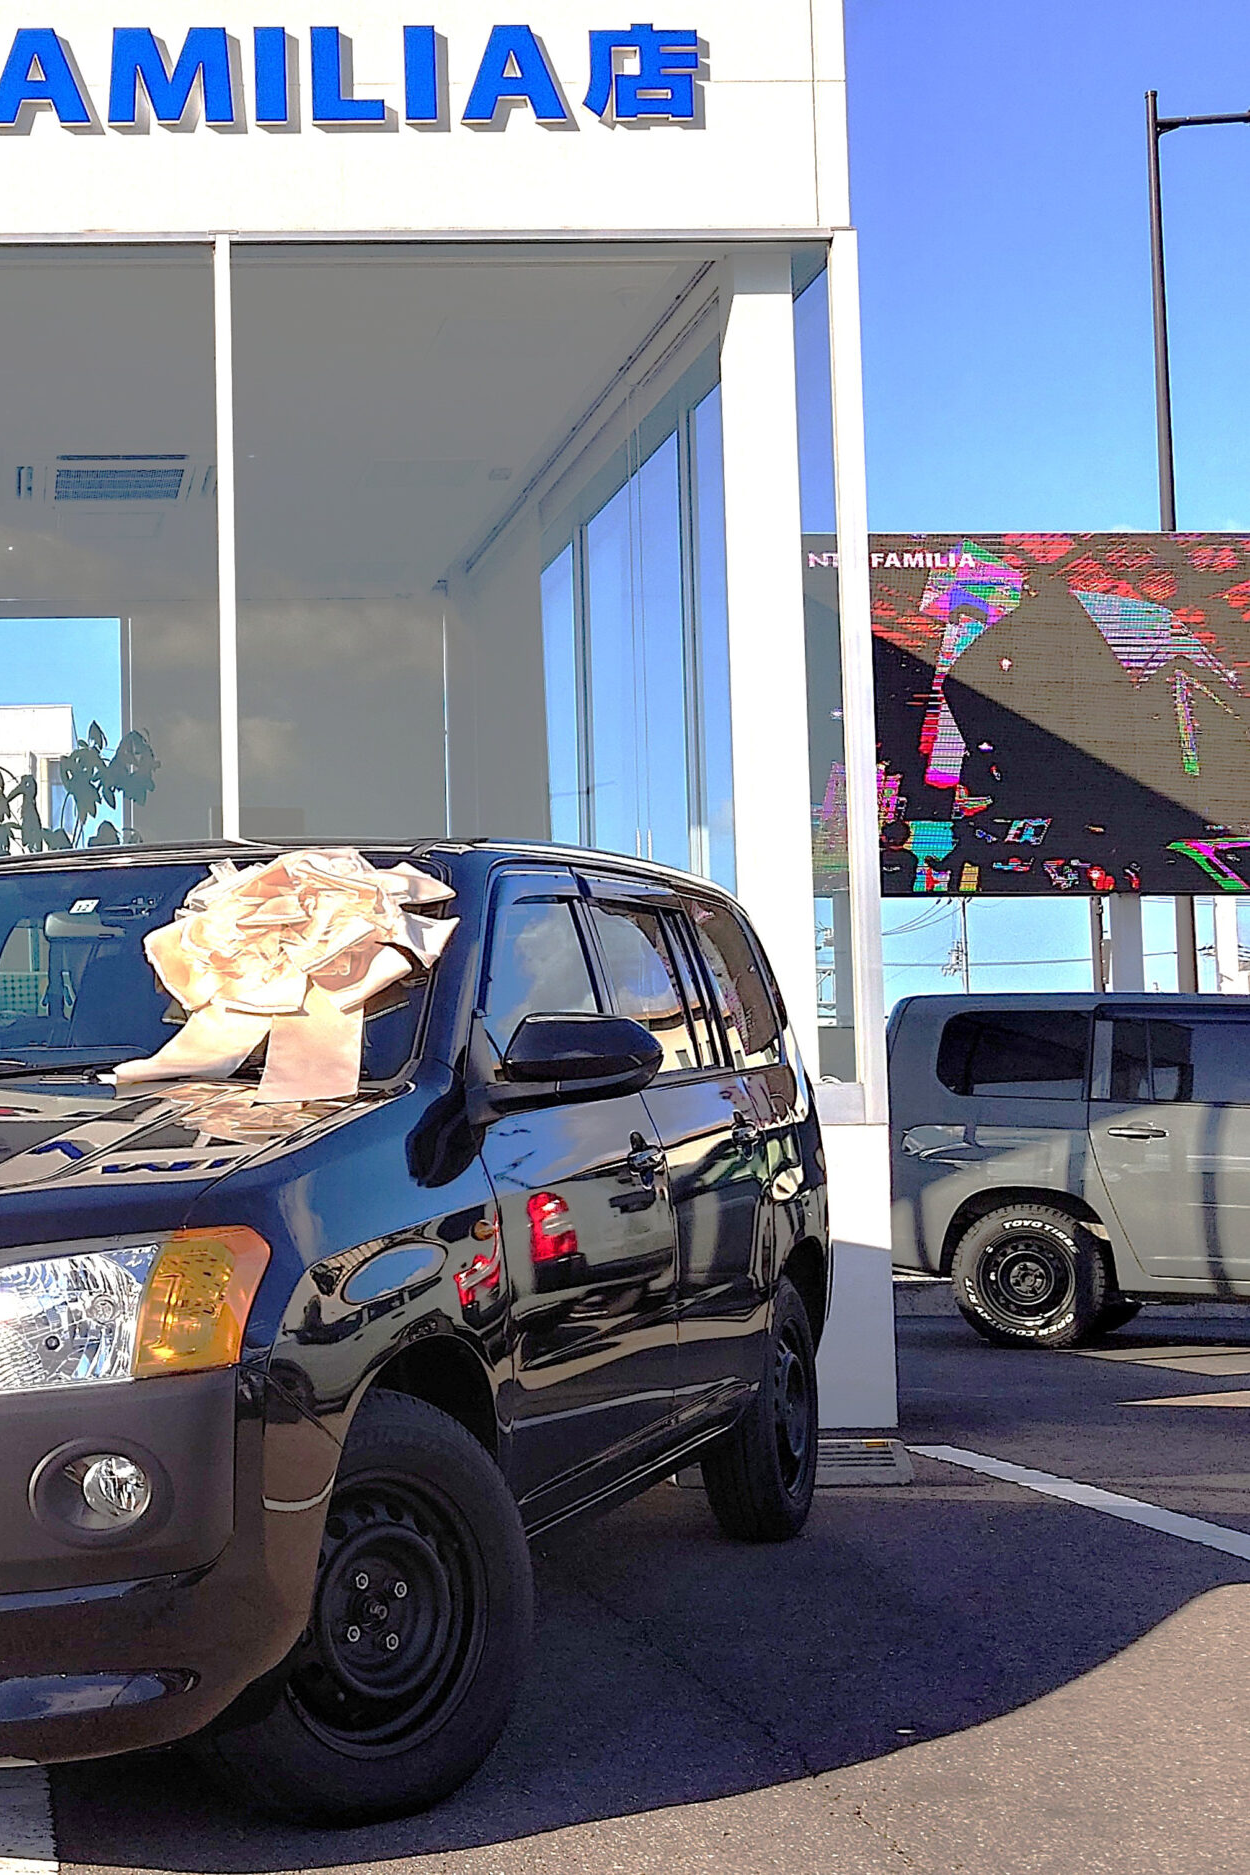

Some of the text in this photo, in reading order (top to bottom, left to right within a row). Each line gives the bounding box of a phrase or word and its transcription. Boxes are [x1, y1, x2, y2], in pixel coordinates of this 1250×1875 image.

[807, 552, 976, 568] NT FAMILIA
[1002, 1219, 1044, 1230] TOYO
